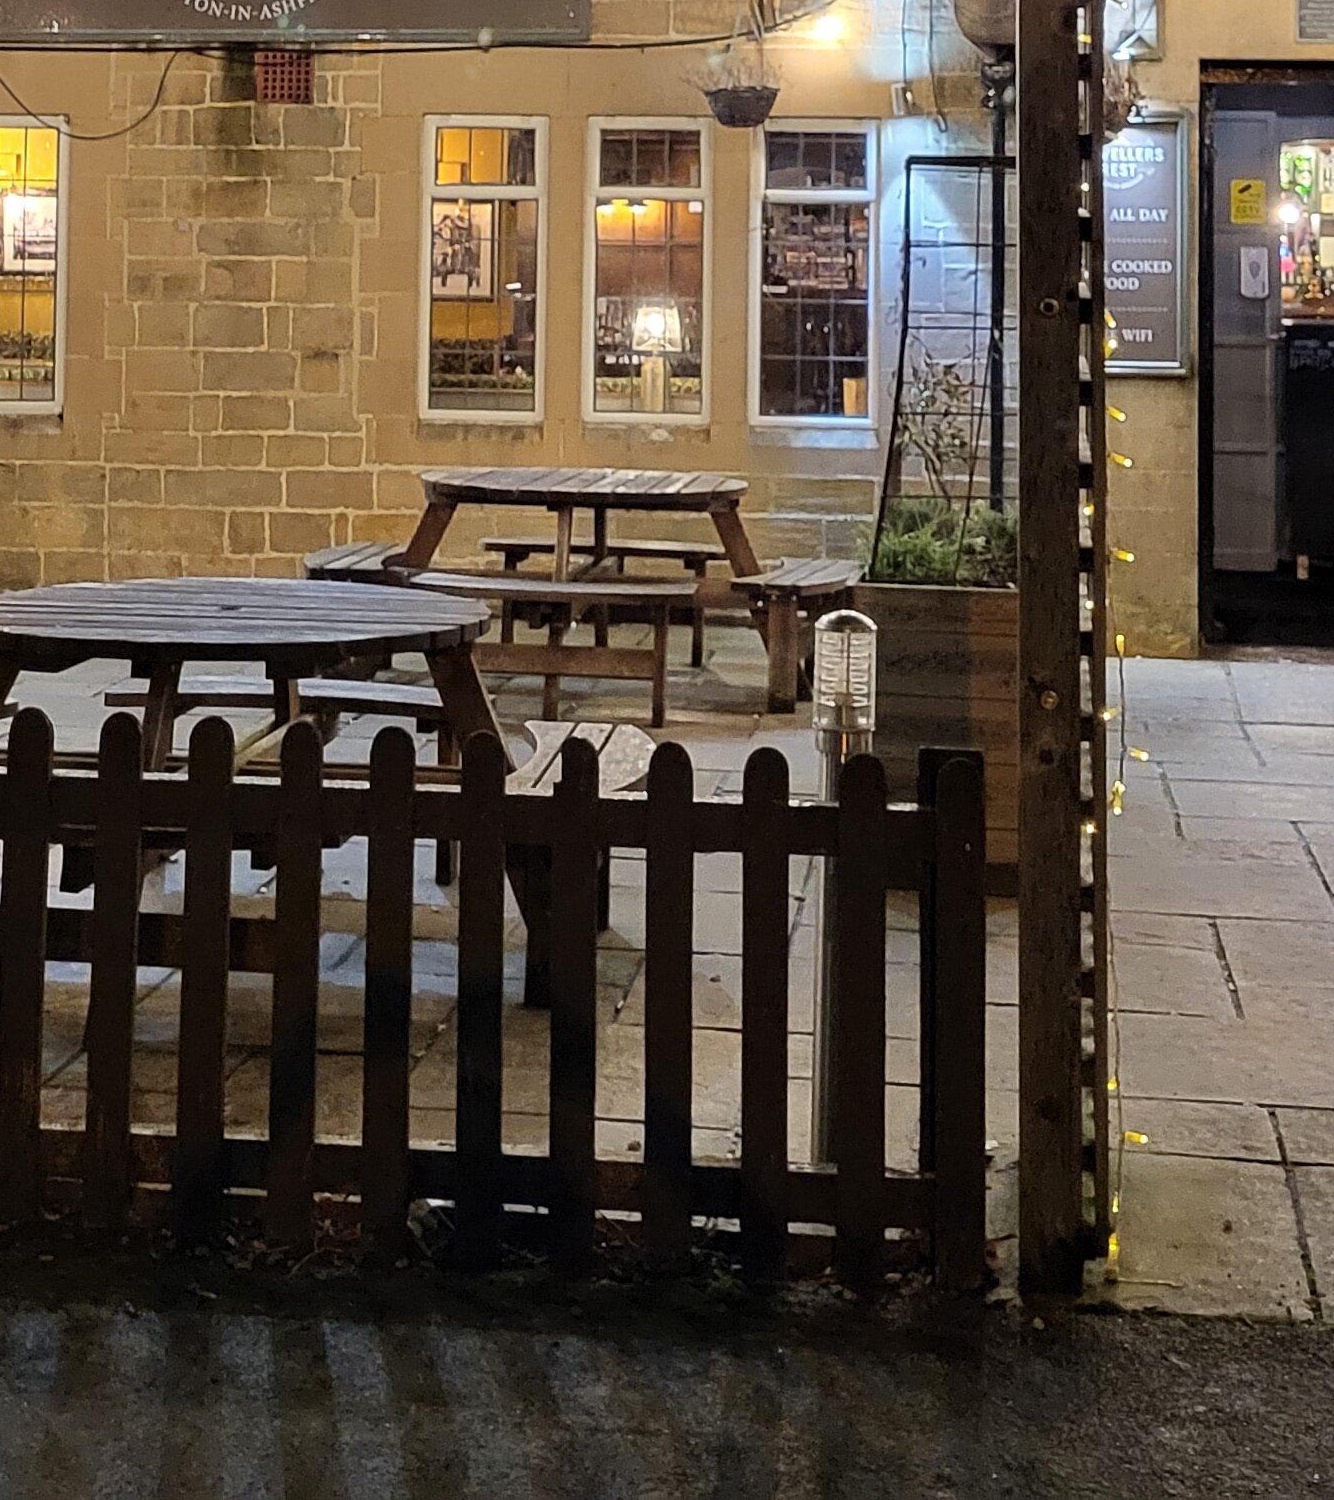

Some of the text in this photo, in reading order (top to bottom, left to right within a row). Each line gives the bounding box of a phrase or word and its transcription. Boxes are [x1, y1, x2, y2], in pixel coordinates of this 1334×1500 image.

[1109, 207, 1169, 223] ALL DAY
[1111, 259, 1173, 274] COOKED
[1104, 277, 1140, 291] OOD
